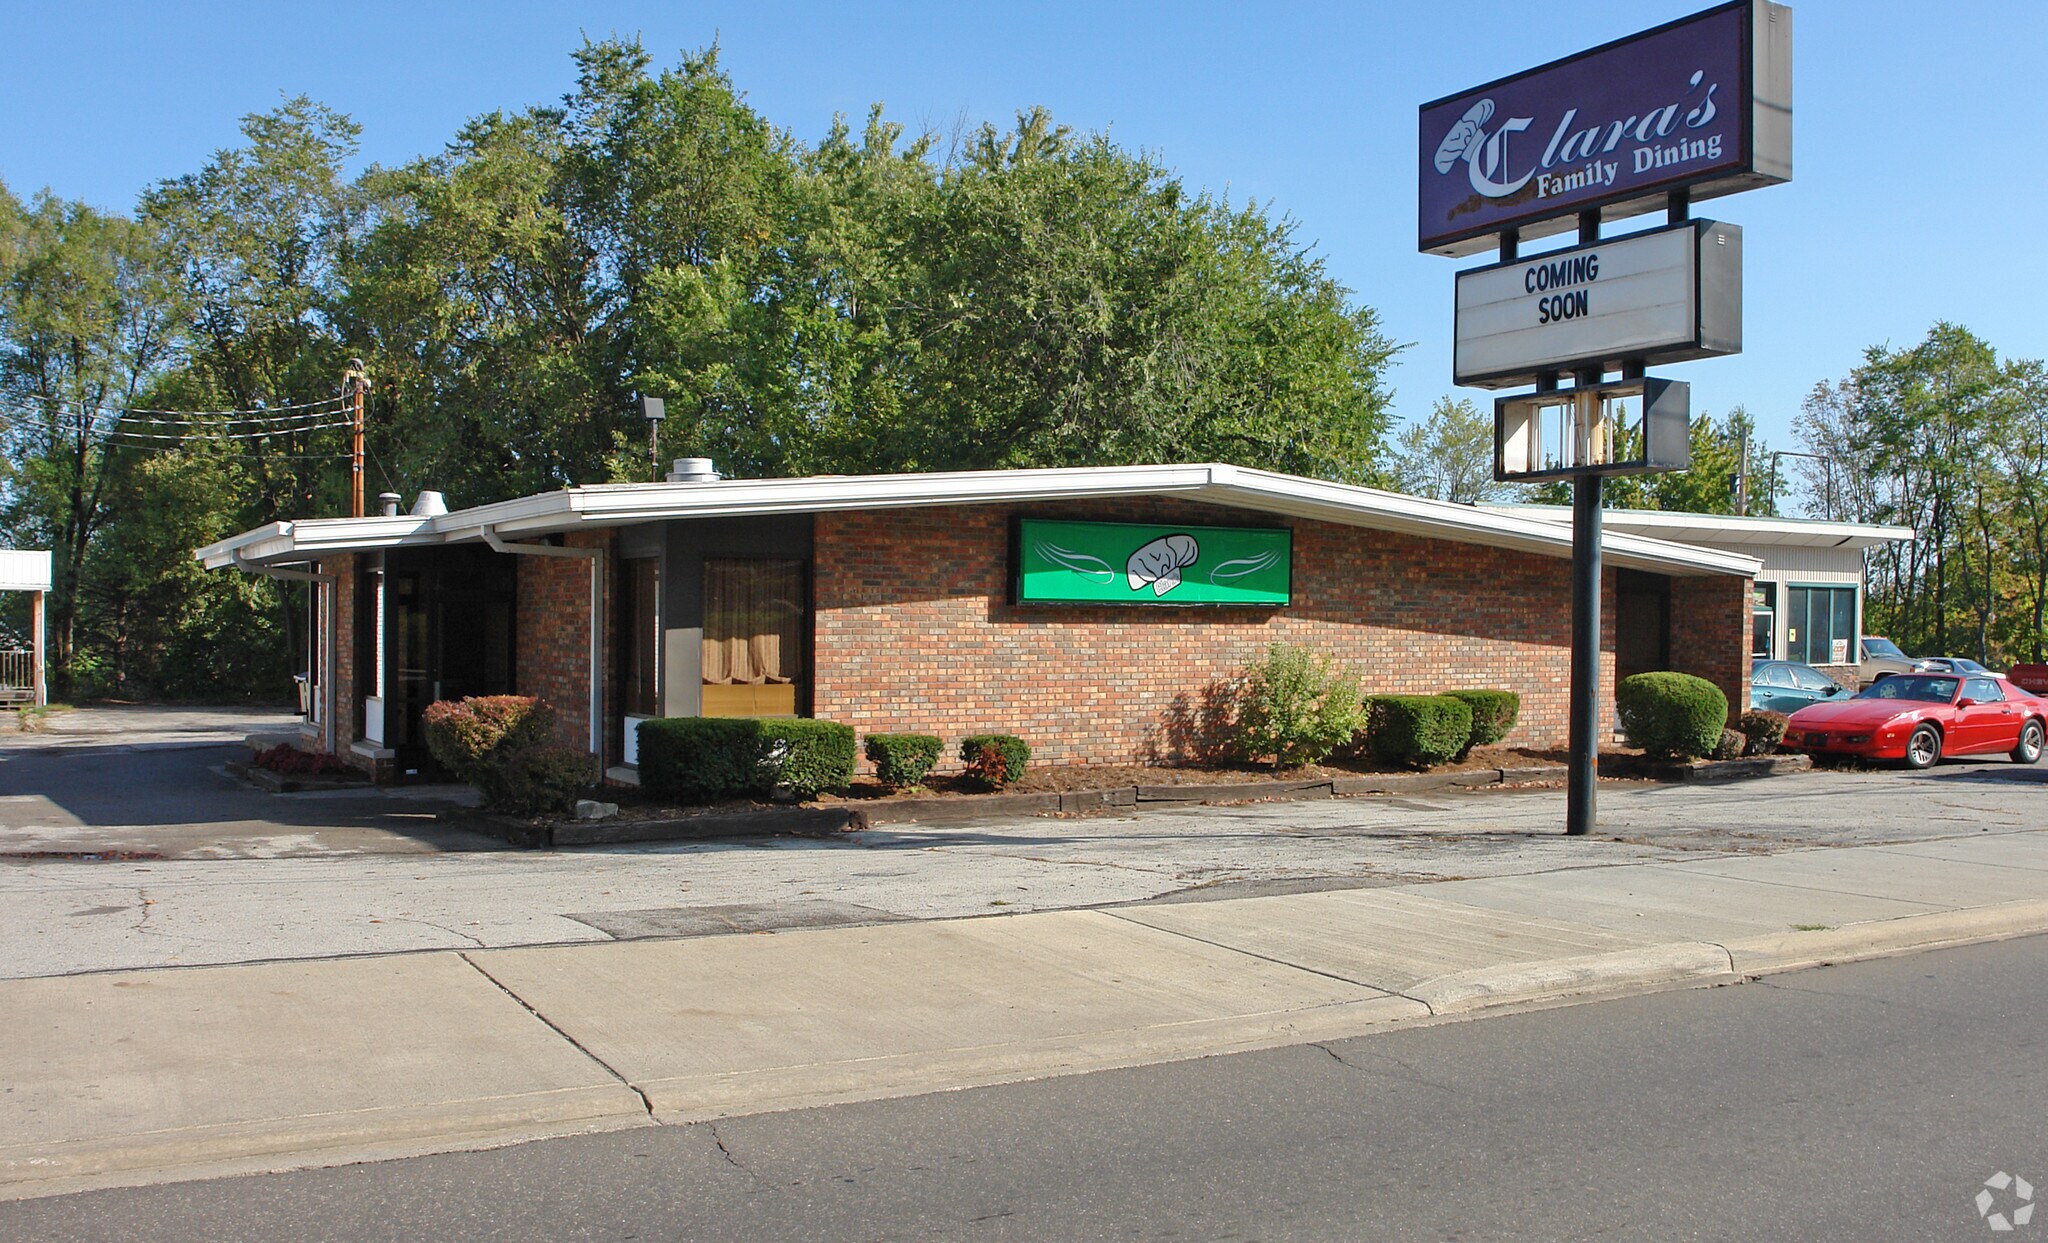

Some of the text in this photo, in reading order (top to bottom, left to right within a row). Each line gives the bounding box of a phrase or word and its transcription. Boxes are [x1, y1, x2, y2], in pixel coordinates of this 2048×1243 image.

[1468, 69, 1718, 198] Clara's
[1536, 133, 1723, 199] Family Dining
[1524, 254, 1599, 294] COMING
[1538, 289, 1589, 324] SOON
